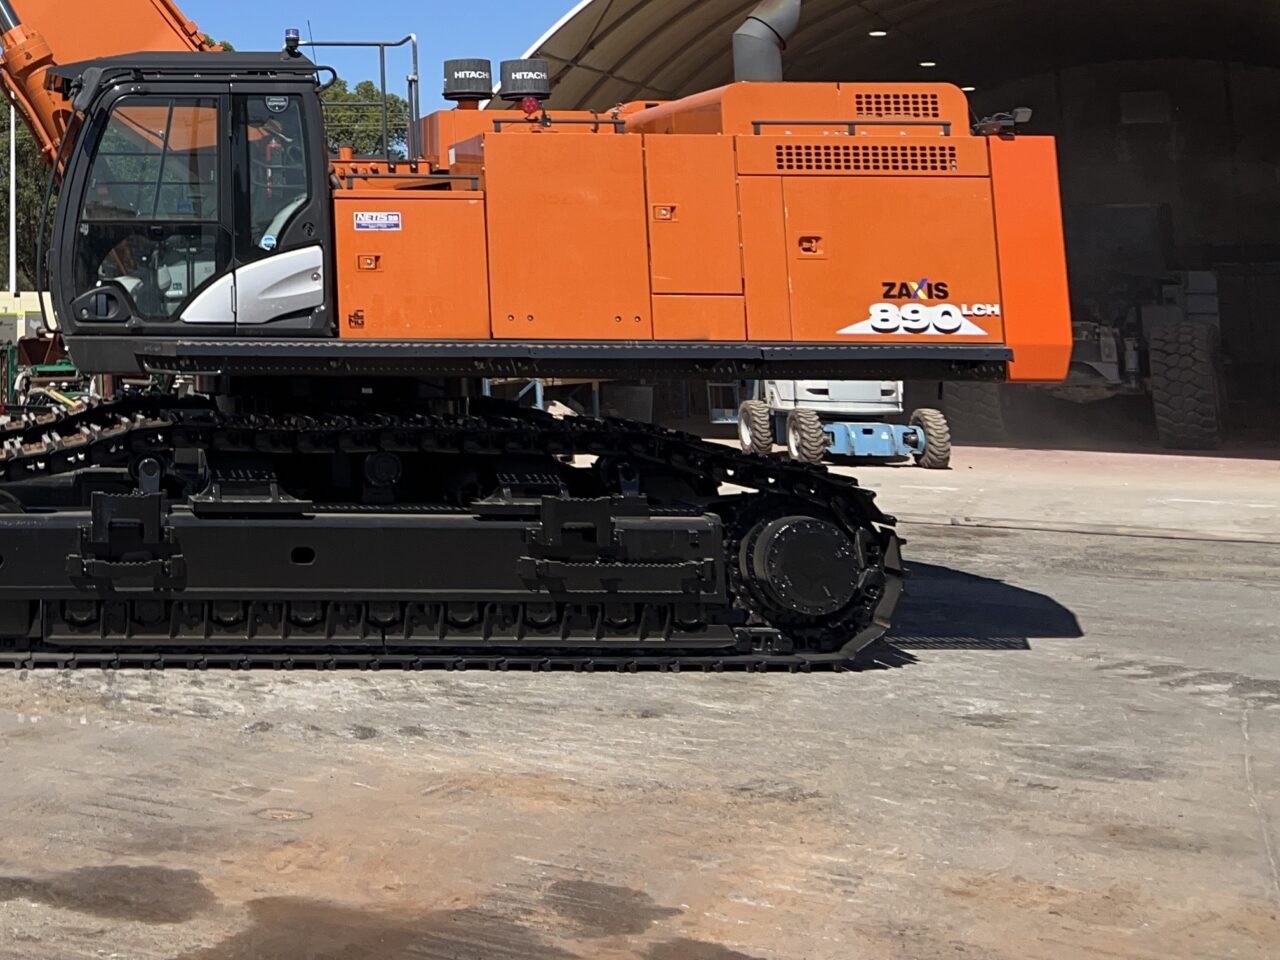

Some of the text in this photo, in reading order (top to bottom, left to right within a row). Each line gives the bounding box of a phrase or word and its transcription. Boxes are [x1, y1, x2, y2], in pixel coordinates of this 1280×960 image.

[882, 278, 949, 300] ZAXIS
[869, 303, 1000, 334] 890 LCH
